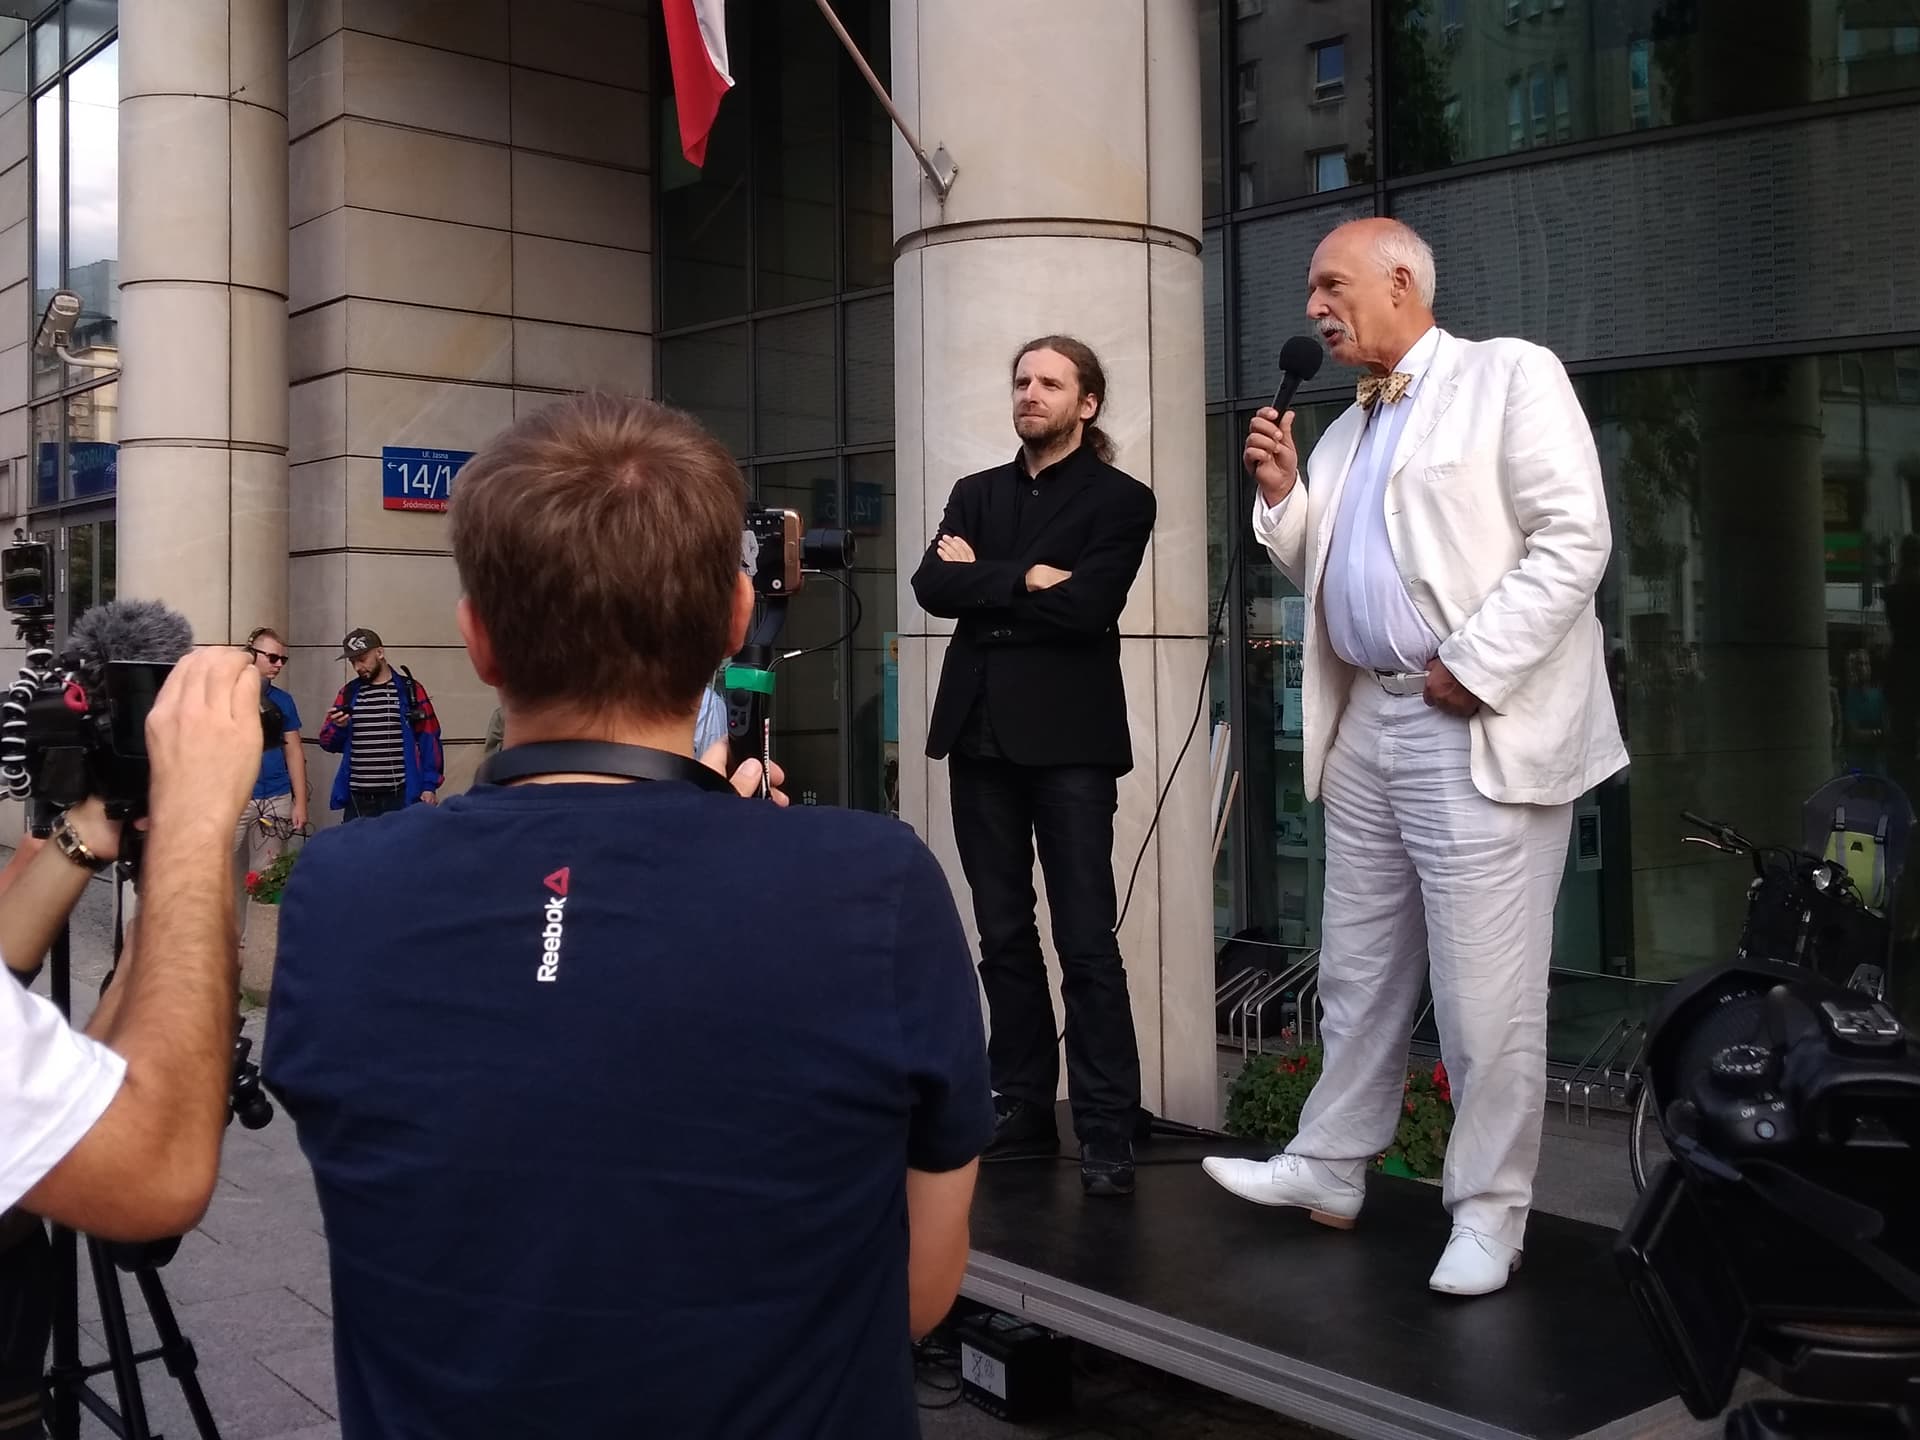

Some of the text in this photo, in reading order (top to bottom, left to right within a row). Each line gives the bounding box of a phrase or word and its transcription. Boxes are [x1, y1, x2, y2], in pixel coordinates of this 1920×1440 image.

[432, 451, 449, 459] Jasna
[537, 897, 567, 981] Reebok
[1771, 1102, 1785, 1112] ON
